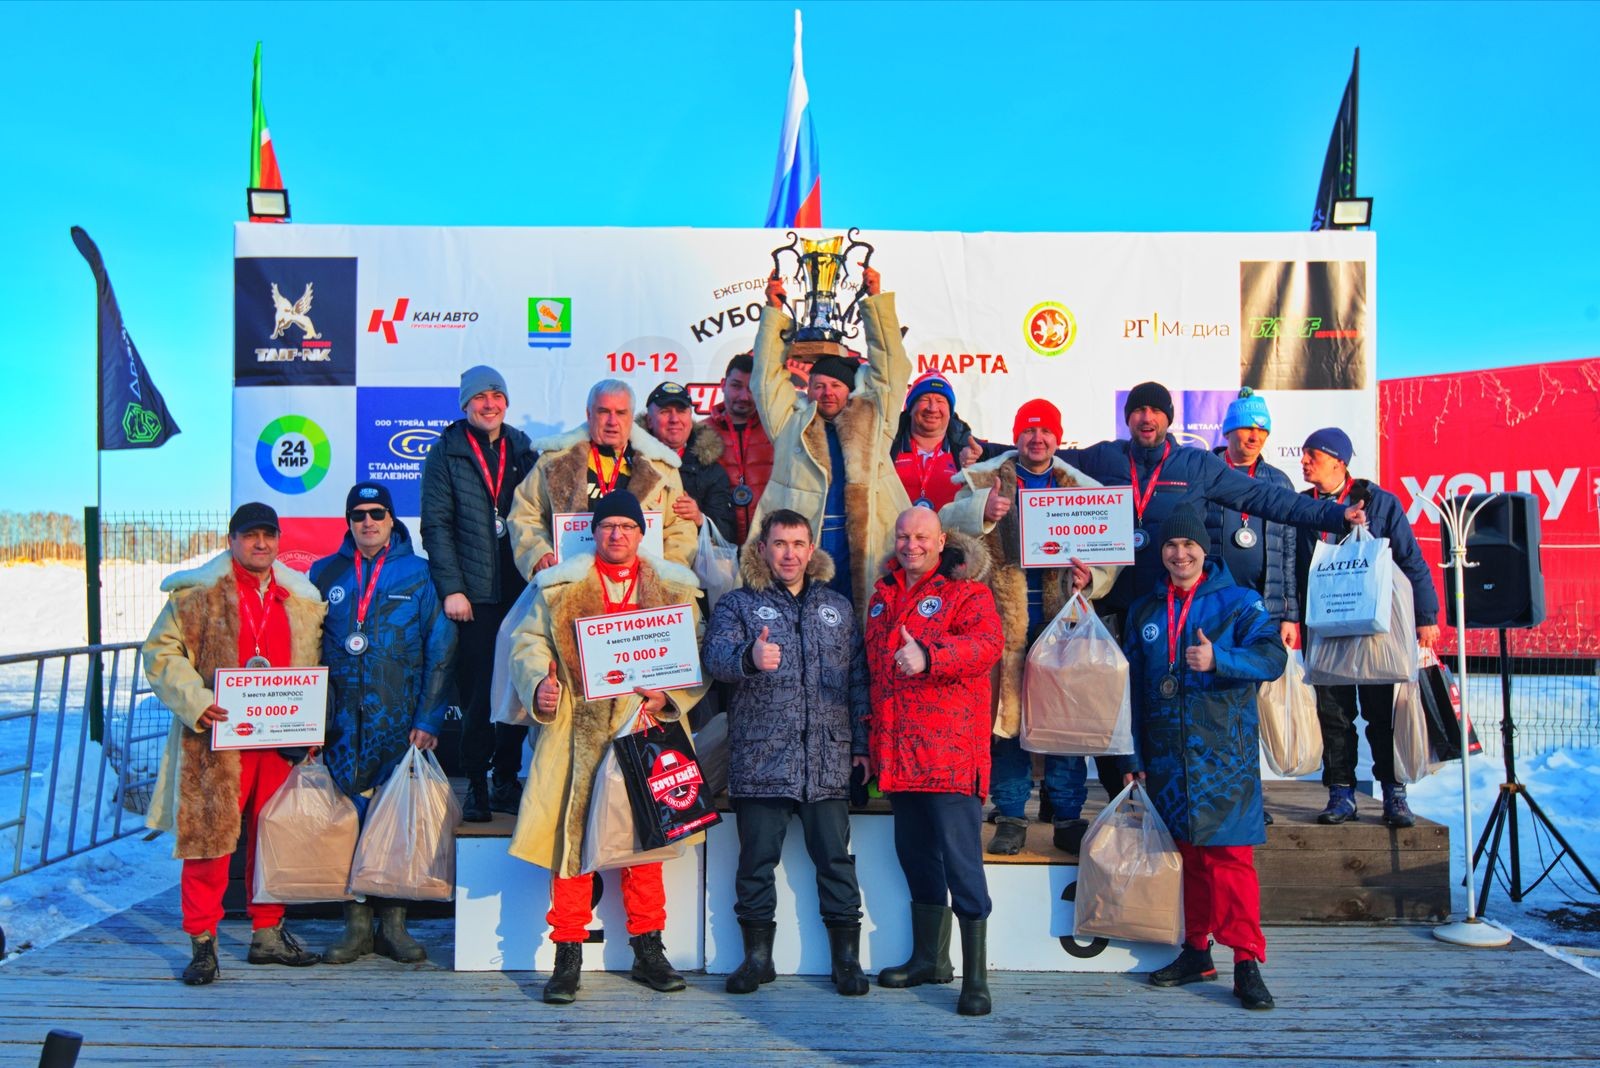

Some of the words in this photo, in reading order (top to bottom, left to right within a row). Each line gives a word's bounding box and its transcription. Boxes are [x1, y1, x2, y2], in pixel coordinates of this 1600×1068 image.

[713, 274, 789, 300] ЕЖЕГОДНЙ
[413, 312, 441, 322] КАН
[443, 312, 479, 322] АВТО
[690, 302, 769, 343] КУБО
[606, 352, 679, 372] 10-12
[917, 354, 1008, 374] МАРТА
[375, 419, 392, 427] ООО
[427, 419, 454, 427] МЕТАЛ
[281, 440, 306, 456] 24
[278, 456, 309, 468] МИР
[368, 462, 421, 471] СТАЛЬНЫЕ
[369, 472, 422, 481] ЖЕЛЕЗНОГ
[1029, 493, 1123, 507] СЕРТИФИКАТ
[1048, 525, 1070, 536] 100
[1073, 524, 1096, 536] 000
[1317, 558, 1369, 572] LATIFA
[587, 612, 684, 636] СЕРТИФИКАТ
[632, 631, 670, 642] АВТОКРОСС
[614, 652, 630, 663] 70
[633, 649, 656, 661] 000
[226, 675, 320, 688] СЕРТИФИКАТ
[246, 706, 262, 717] 50
[265, 705, 287, 716] 000
[651, 775, 676, 793] ХОЧУ
